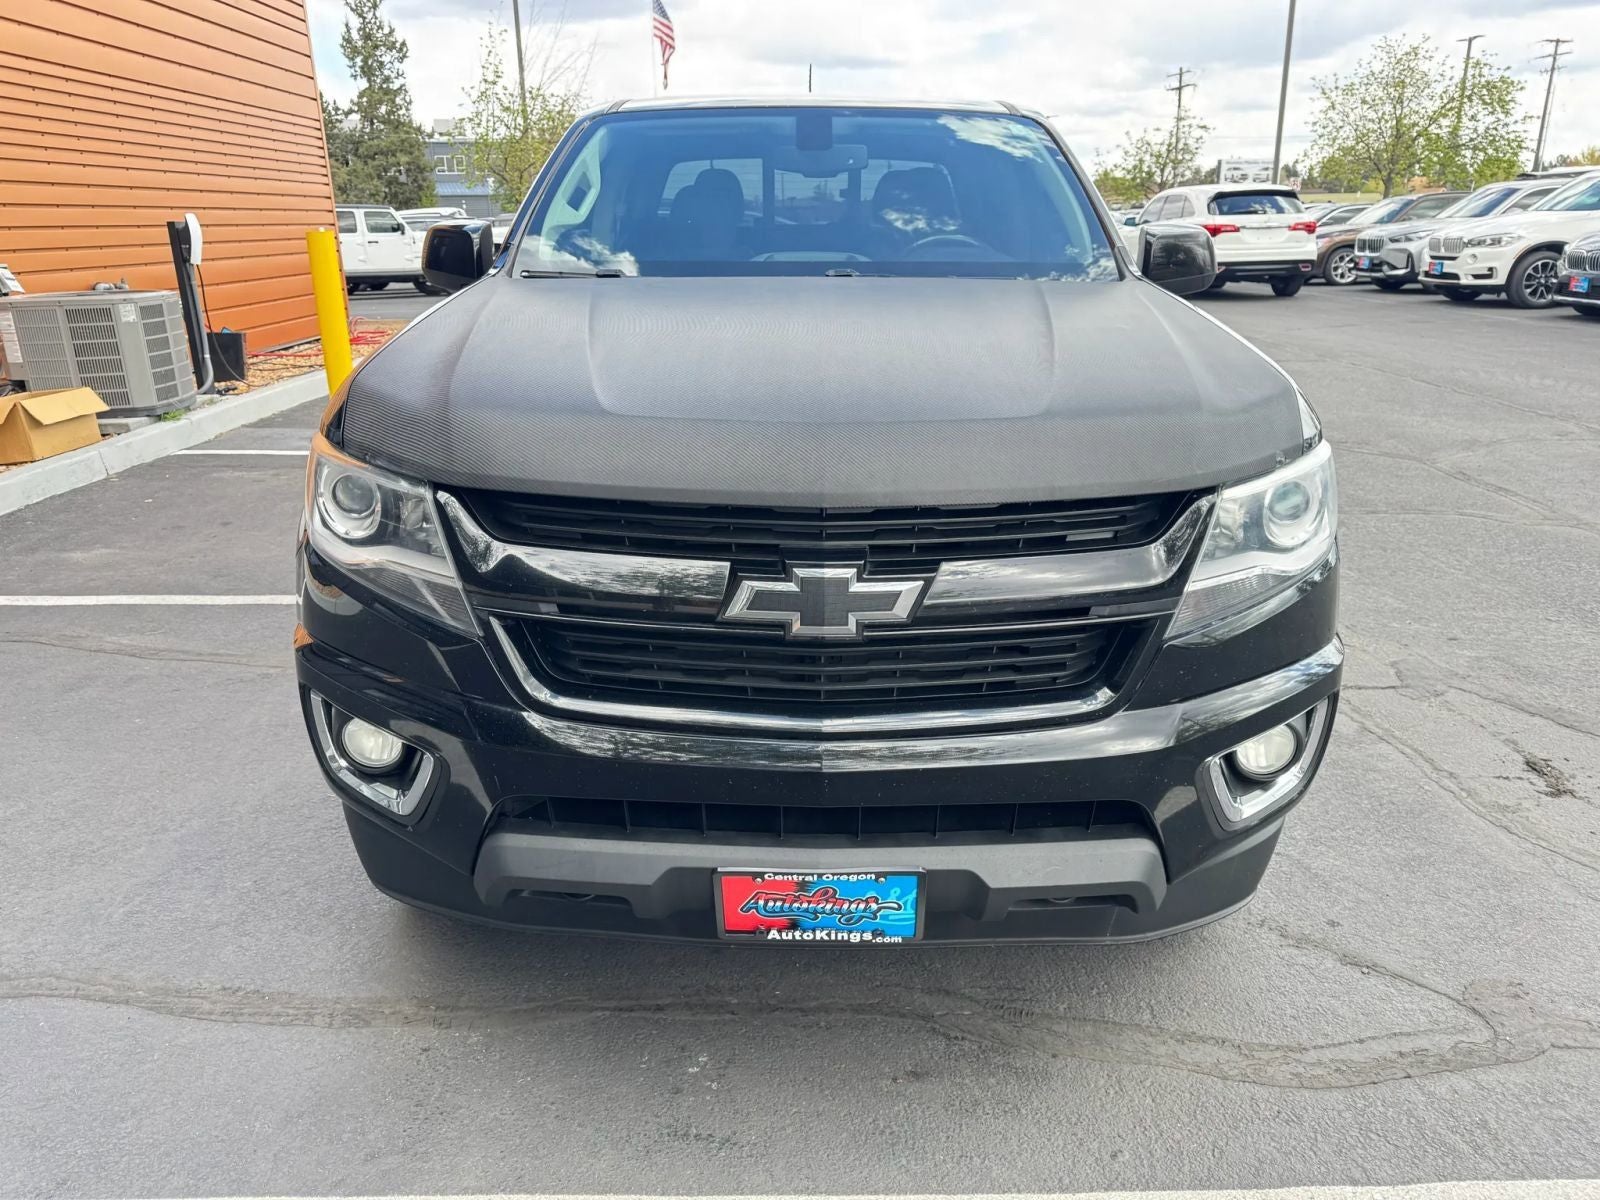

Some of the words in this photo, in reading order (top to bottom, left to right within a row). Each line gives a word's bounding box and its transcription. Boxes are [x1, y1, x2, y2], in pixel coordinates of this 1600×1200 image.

[764, 873, 817, 881] Central
[822, 873, 876, 882] Oregon
[767, 929, 902, 943] AutoKings.com
